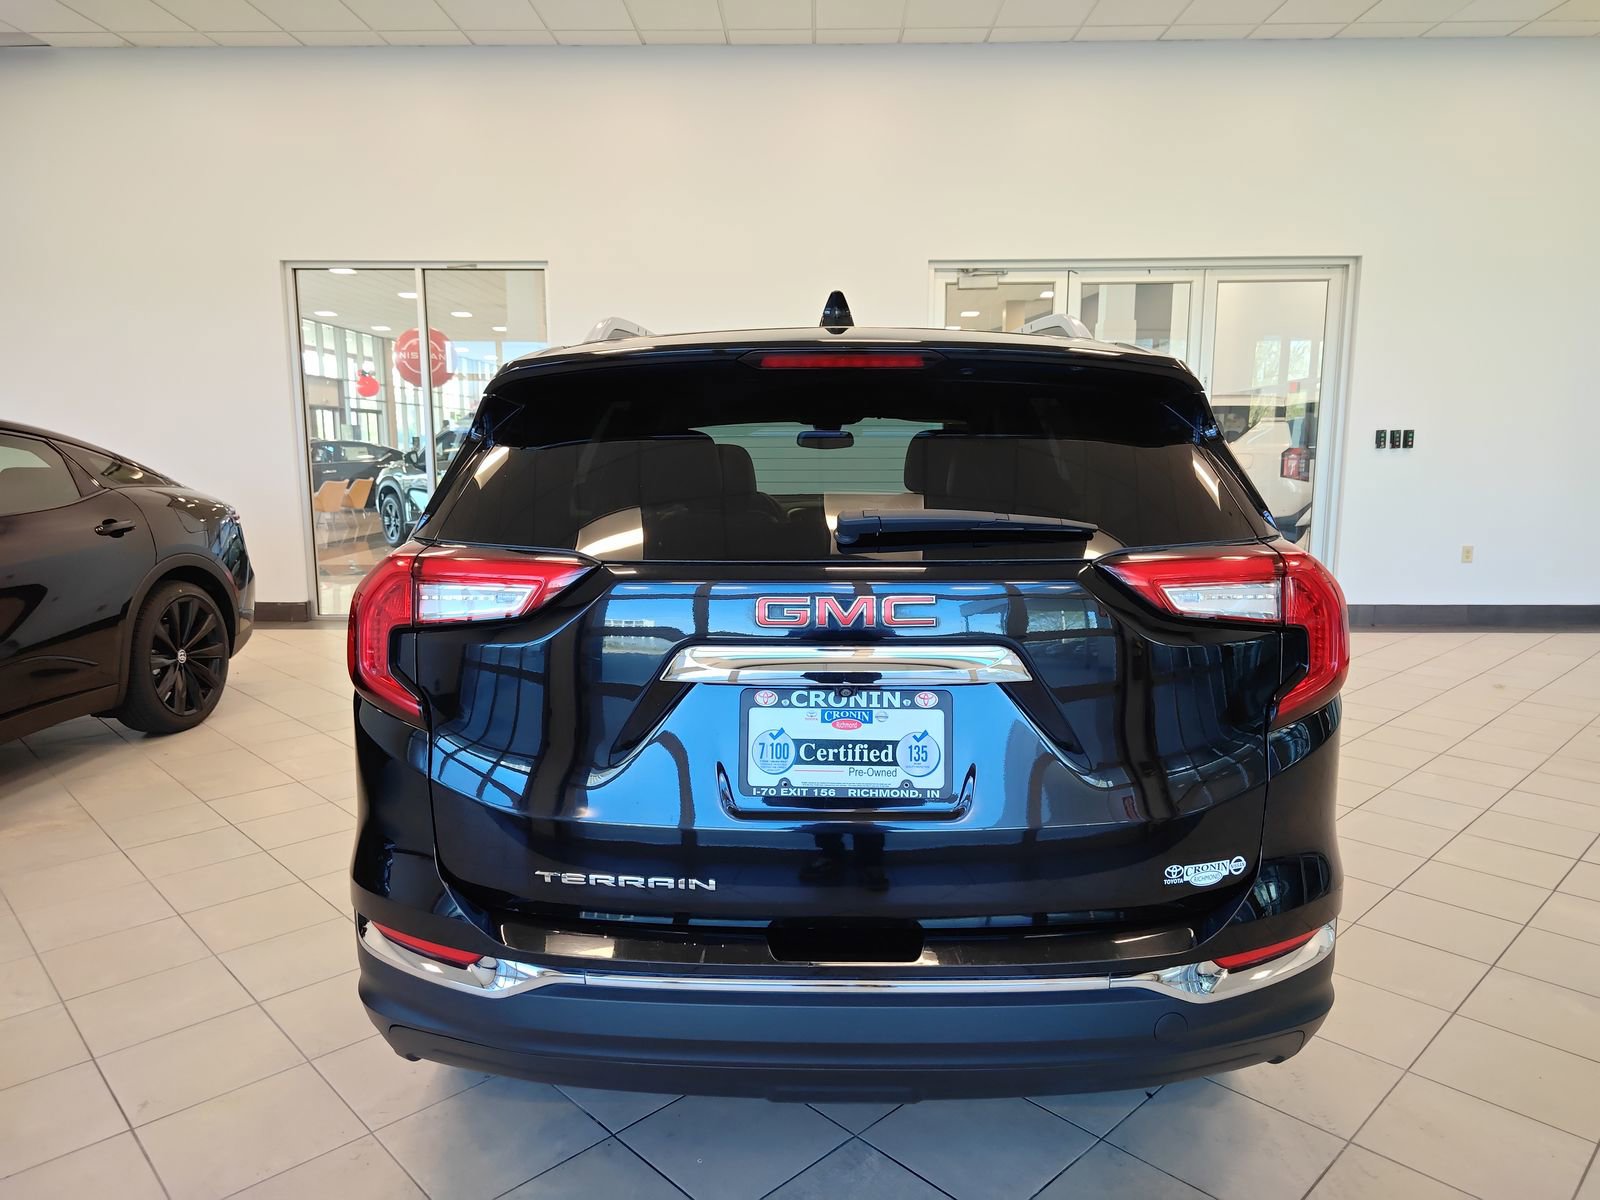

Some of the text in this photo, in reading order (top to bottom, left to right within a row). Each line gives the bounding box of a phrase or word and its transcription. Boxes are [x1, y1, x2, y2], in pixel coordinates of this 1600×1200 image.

[400, 352, 446, 360] NISAN
[755, 595, 937, 628] GMC
[790, 690, 901, 708] CRONIN
[824, 710, 870, 722] CRONIN
[799, 743, 894, 763] Certified
[908, 744, 928, 762] 135
[848, 767, 897, 778] Pre-Owned
[752, 787, 940, 798] I-70 EXIT 156 RICHMOND, IN
[1185, 862, 1228, 877] CRONIN
[534, 870, 716, 892] TERRAIN
[1193, 873, 1220, 882] RICHMOND
